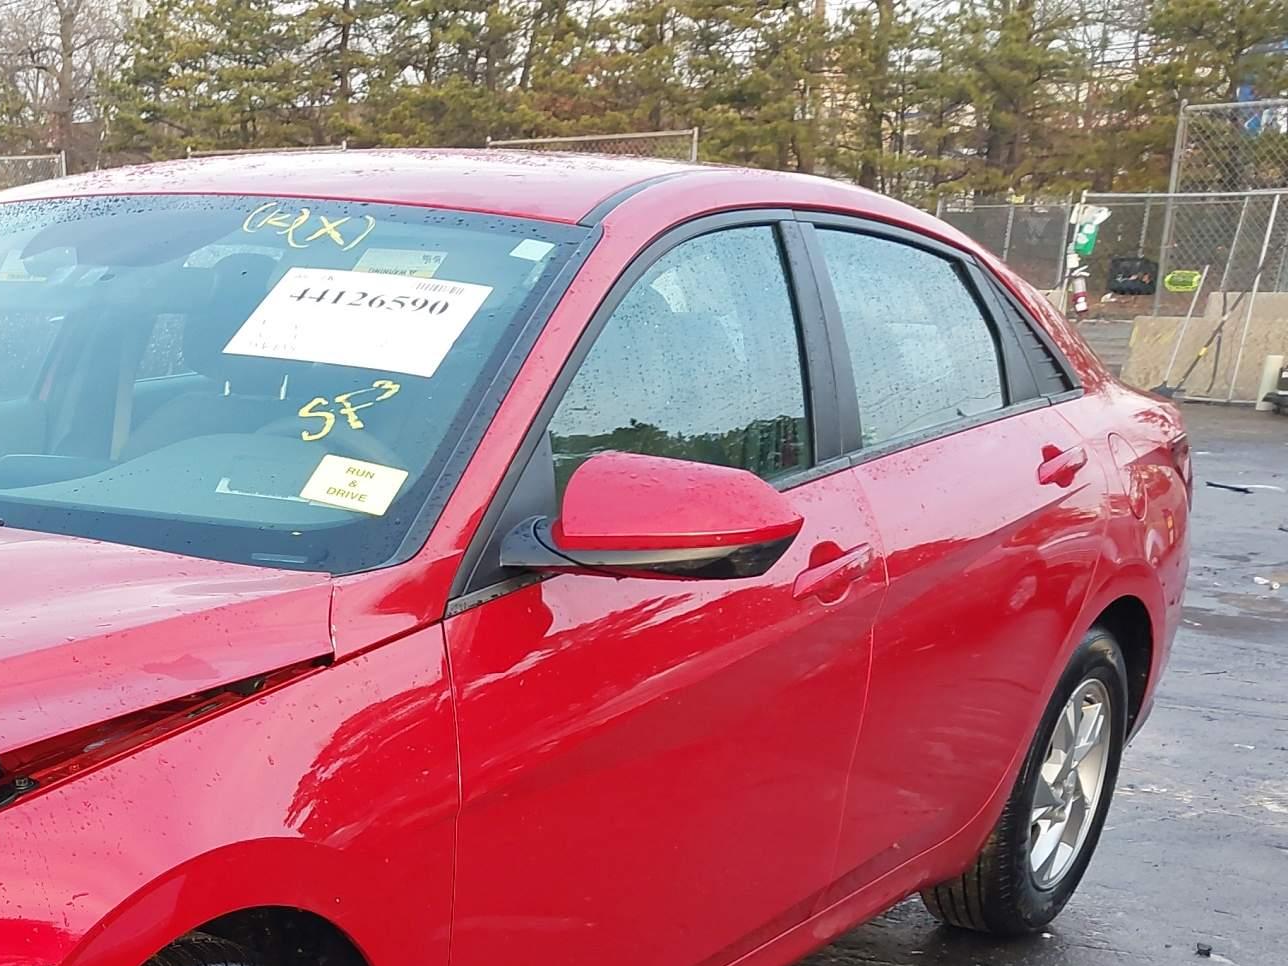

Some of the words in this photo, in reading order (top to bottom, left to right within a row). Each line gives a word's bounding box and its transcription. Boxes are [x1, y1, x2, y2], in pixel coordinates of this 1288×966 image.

[289, 287, 450, 315] 44126590
[345, 467, 376, 479] RUN
[348, 480, 358, 488] &
[326, 487, 368, 503] DRIVE
